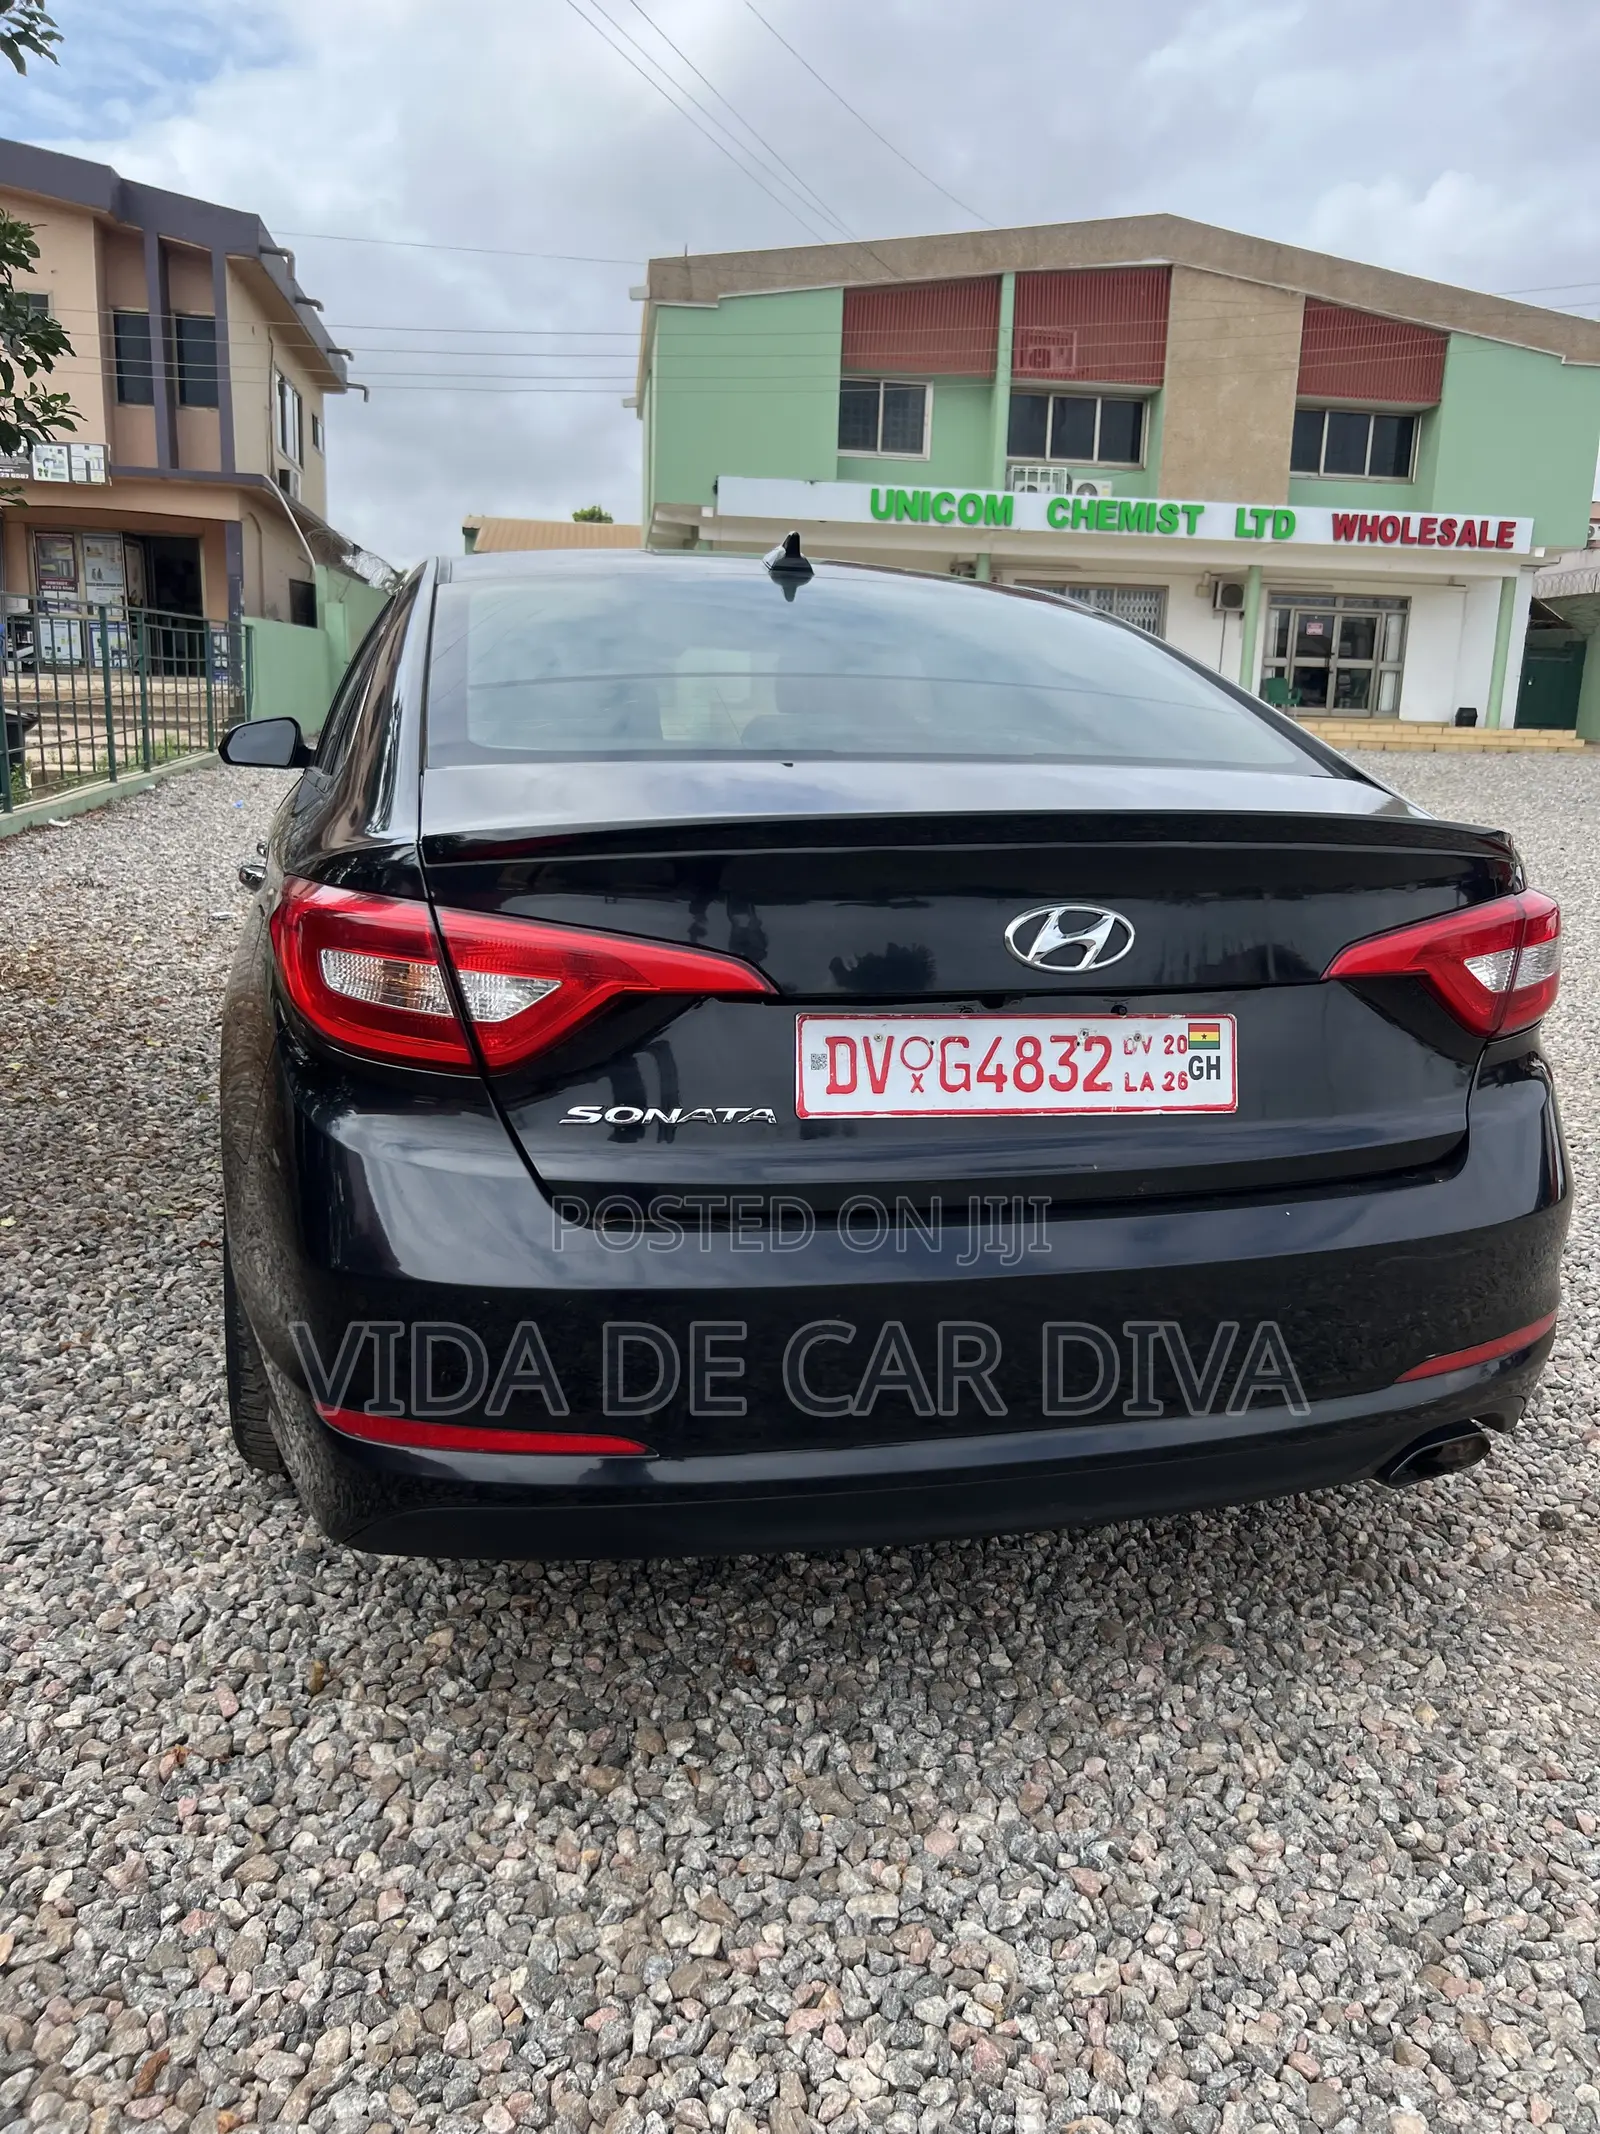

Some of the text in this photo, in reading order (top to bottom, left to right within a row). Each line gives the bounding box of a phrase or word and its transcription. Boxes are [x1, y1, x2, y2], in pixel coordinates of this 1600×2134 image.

[870, 488, 1516, 549] UNICOM CHEMIST LTD WHOLESALE
[1123, 1034, 1188, 1055] DV 20
[1188, 1055, 1221, 1080] GH
[1124, 1071, 1188, 1092] LA 26
[559, 1105, 778, 1124] SONATA
